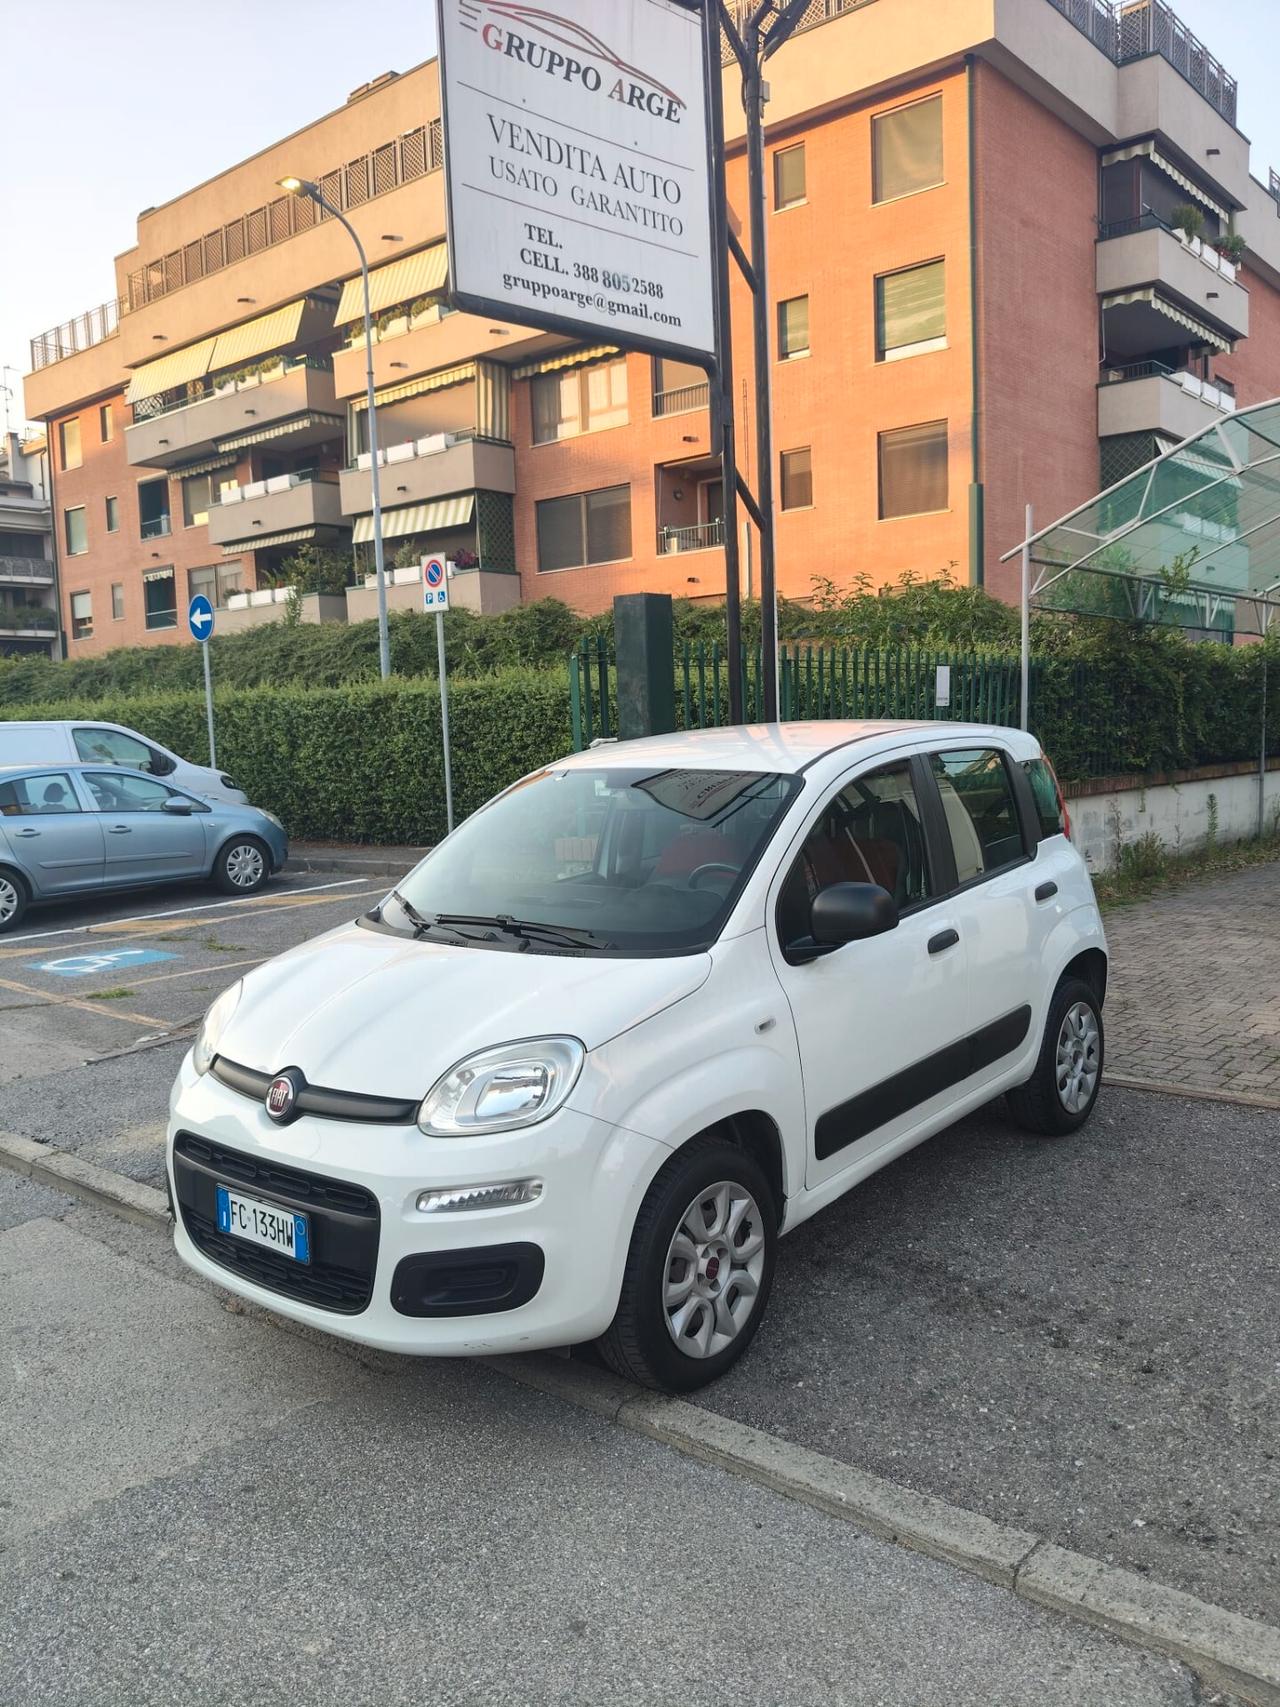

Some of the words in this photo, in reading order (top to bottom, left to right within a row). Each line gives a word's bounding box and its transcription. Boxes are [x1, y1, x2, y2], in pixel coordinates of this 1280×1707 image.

[482, 23, 602, 92] GRUPPO
[607, 78, 682, 124] ARGE
[486, 113, 607, 182] VENDITA
[613, 162, 681, 205] AUTO
[489, 155, 558, 197] USATO
[571, 185, 683, 237] GARANTITO
[524, 223, 563, 249] TEL.
[503, 273, 682, 328] gruppoarge@gmail.com
[520, 248, 569, 275] CELL.
[573, 262, 599, 283] 388
[632, 277, 664, 299] 2588
[271, 1087, 288, 1107] FIAT
